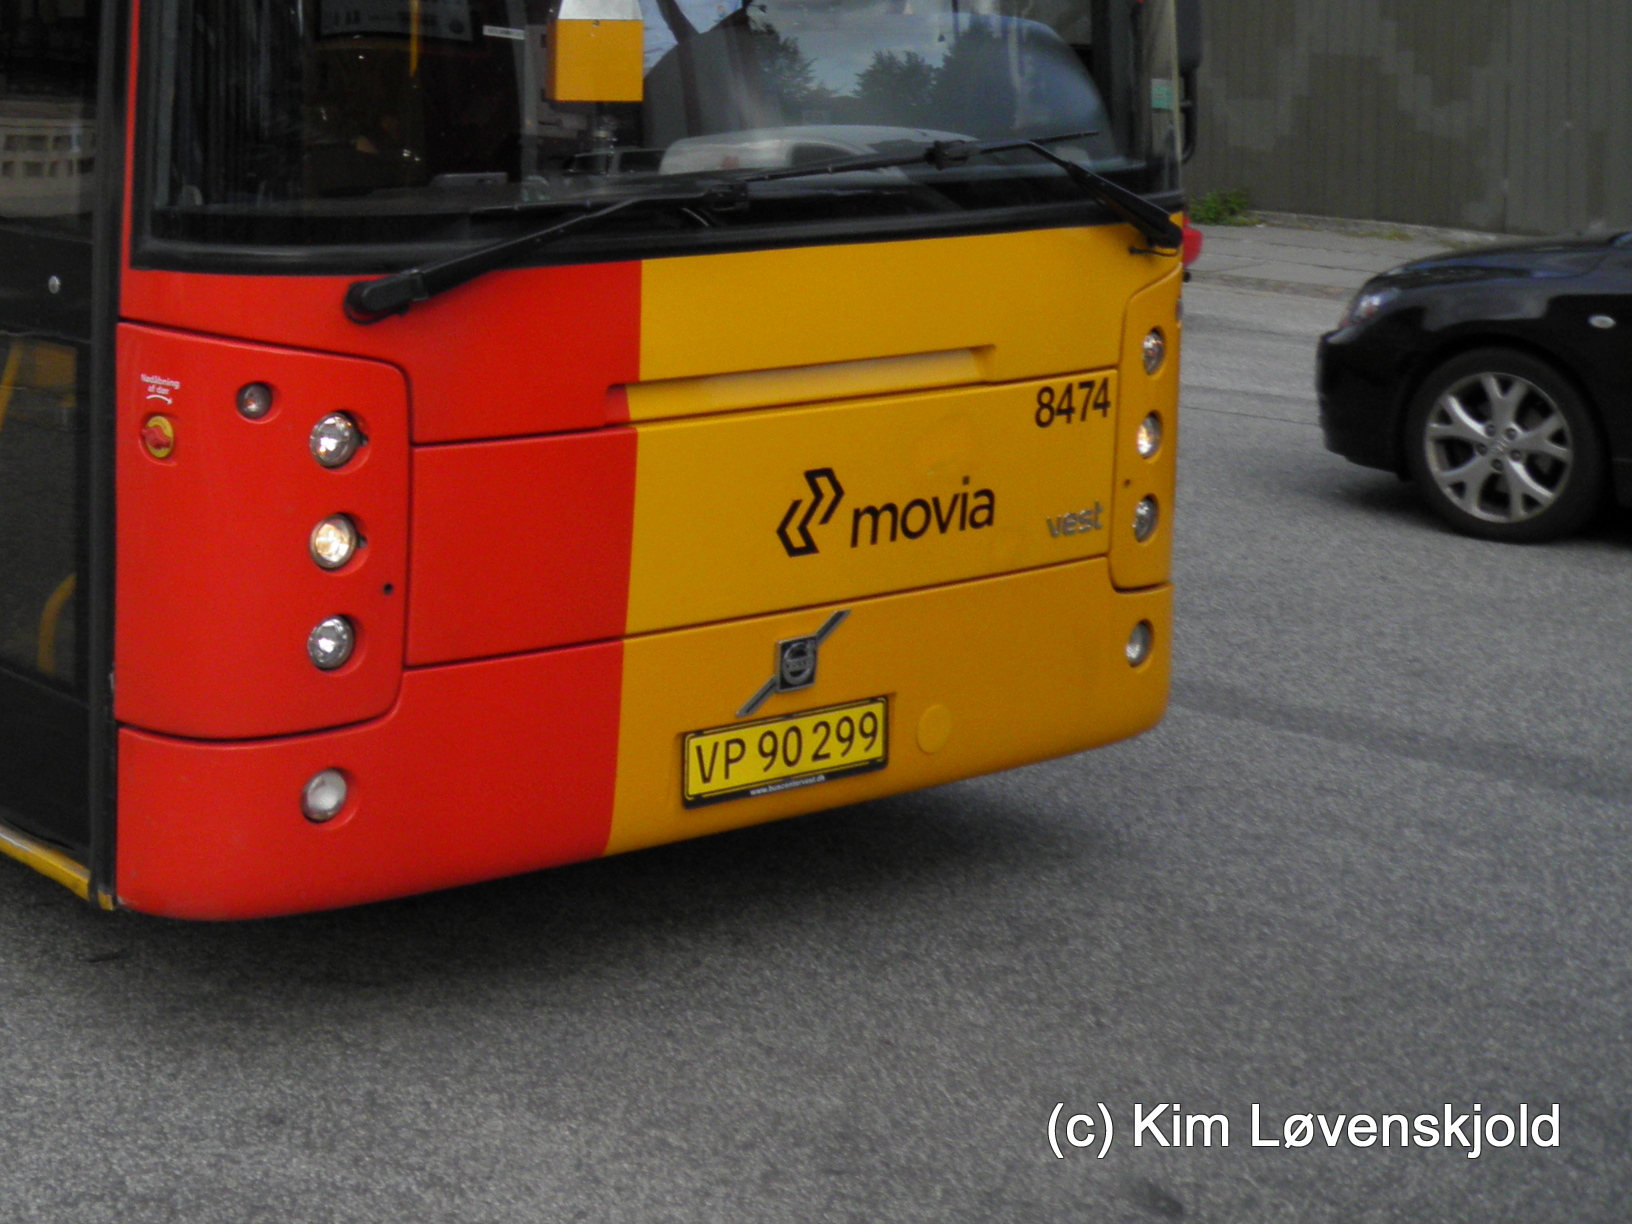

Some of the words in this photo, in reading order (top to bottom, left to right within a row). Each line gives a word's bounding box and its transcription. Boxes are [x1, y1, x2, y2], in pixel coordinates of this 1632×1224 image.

[147, 384, 156, 393] af
[1034, 377, 1111, 428] 8474
[850, 475, 995, 549] movia
[1047, 499, 1103, 538] vest
[696, 738, 746, 784] VP
